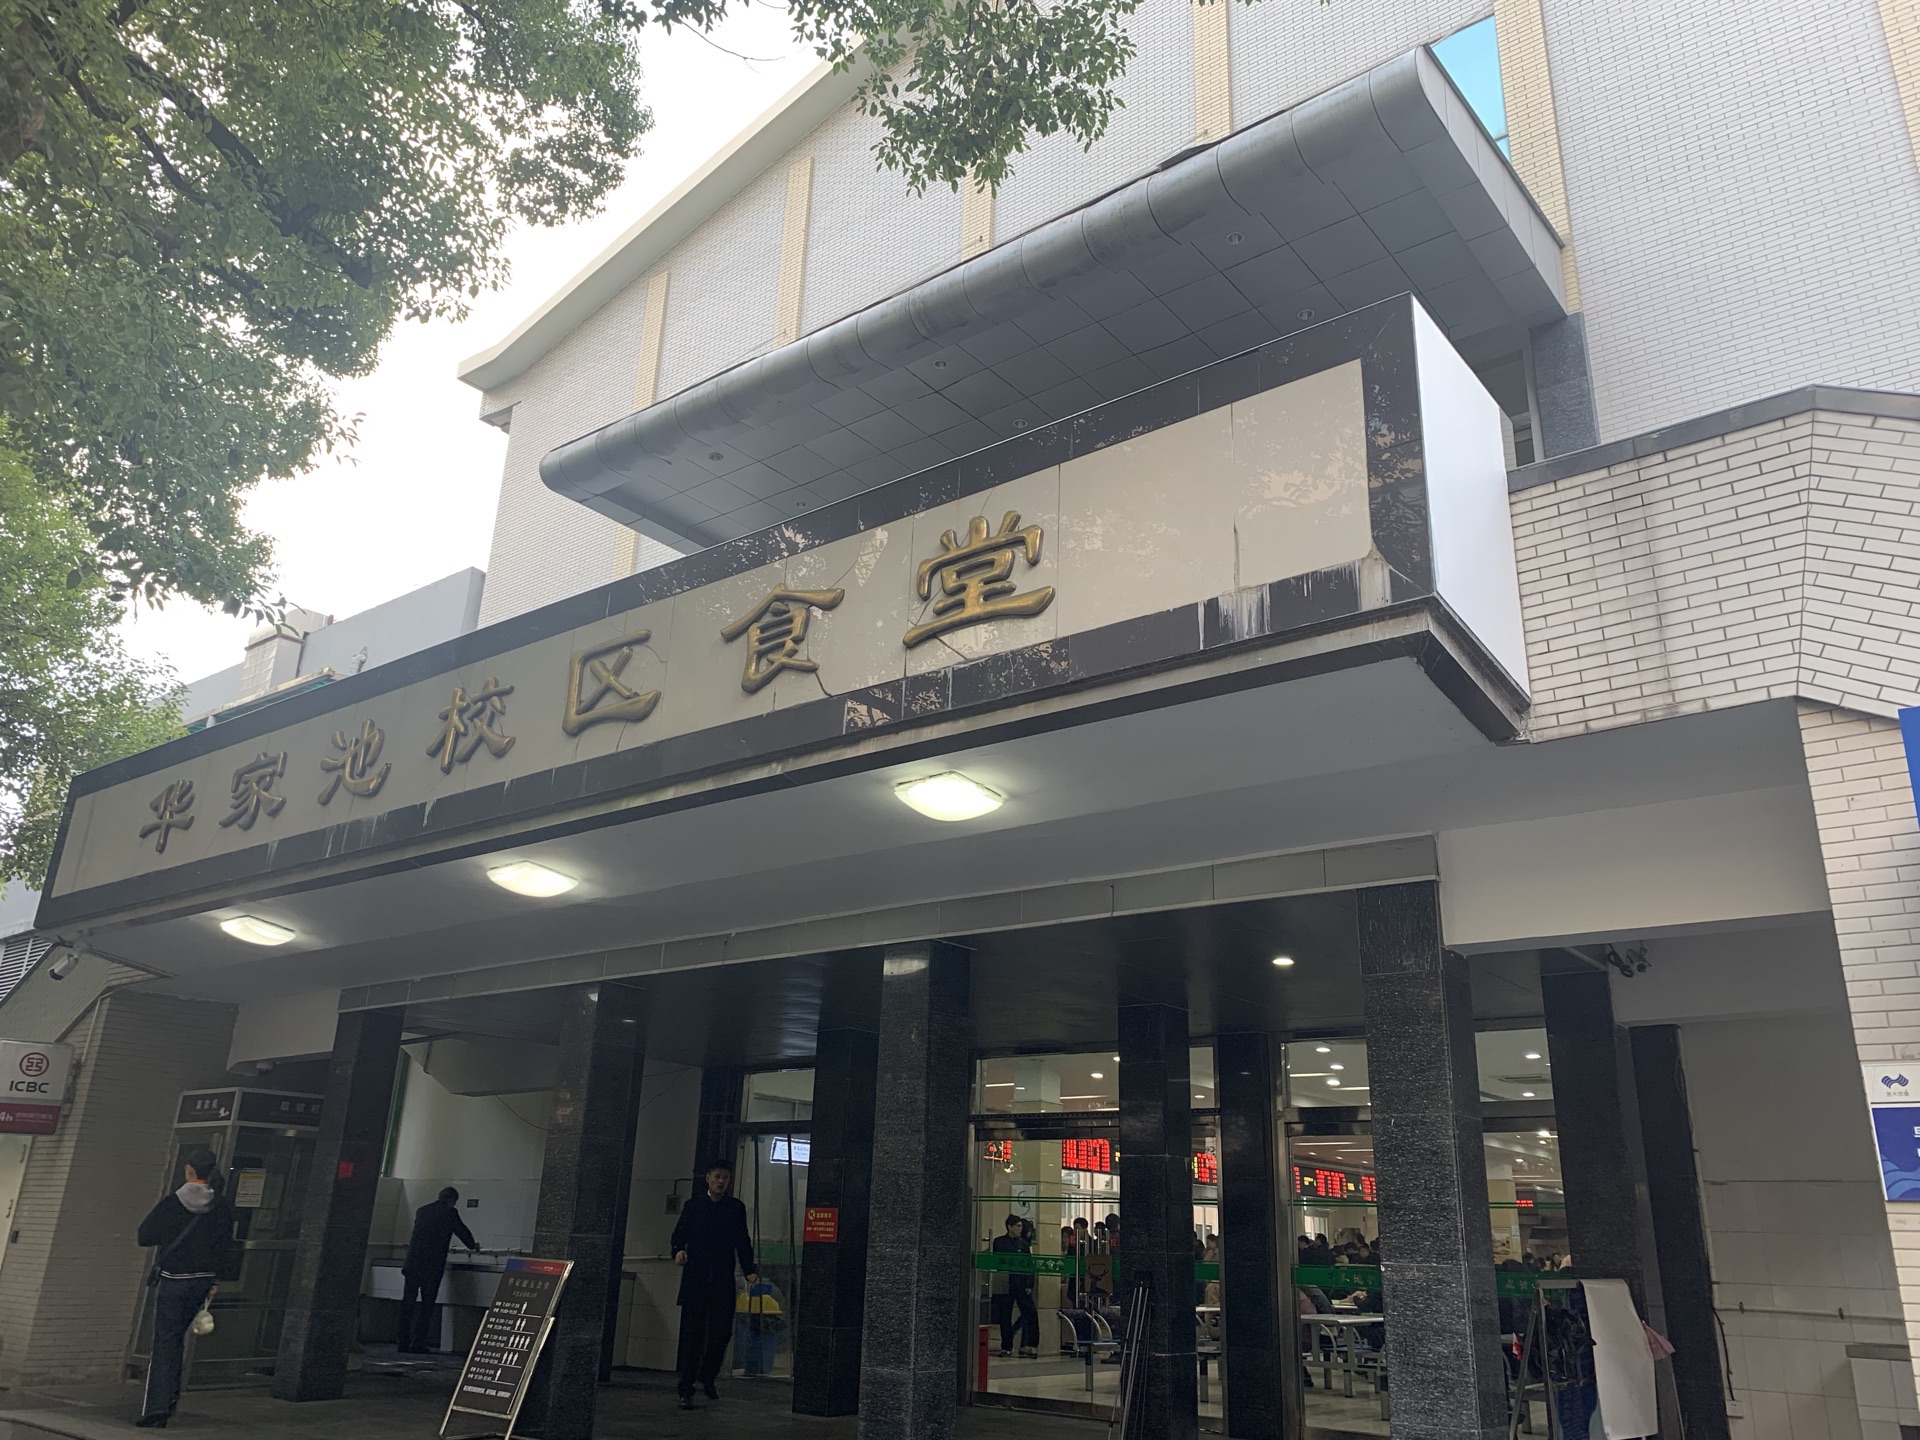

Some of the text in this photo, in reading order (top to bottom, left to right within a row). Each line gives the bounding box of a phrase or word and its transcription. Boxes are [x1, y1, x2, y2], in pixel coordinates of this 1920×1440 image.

[139, 510, 1055, 854] 华家池校区食堂
[9, 1080, 49, 1094] ICBC
